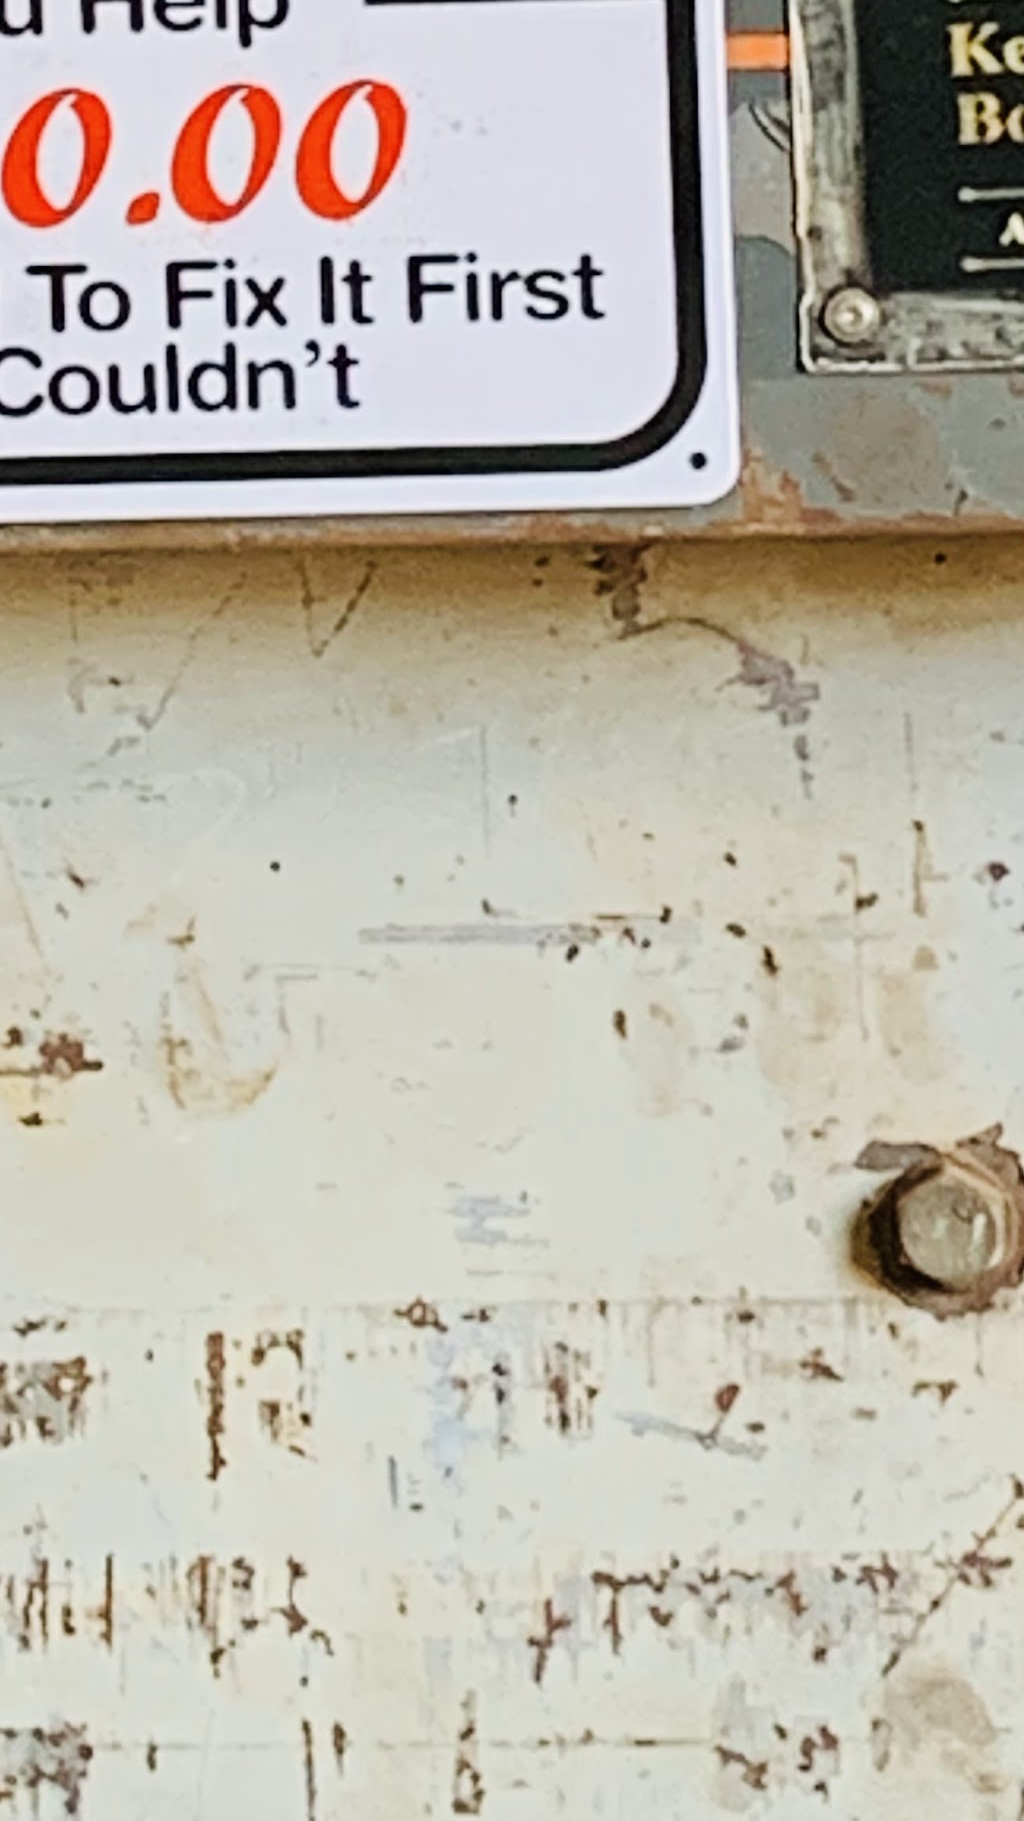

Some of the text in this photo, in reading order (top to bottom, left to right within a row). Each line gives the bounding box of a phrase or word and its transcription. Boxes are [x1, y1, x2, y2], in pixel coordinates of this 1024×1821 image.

[25, 264, 131, 333] To
[165, 258, 287, 330] Fix
[320, 256, 374, 325] It
[407, 252, 605, 324] First
